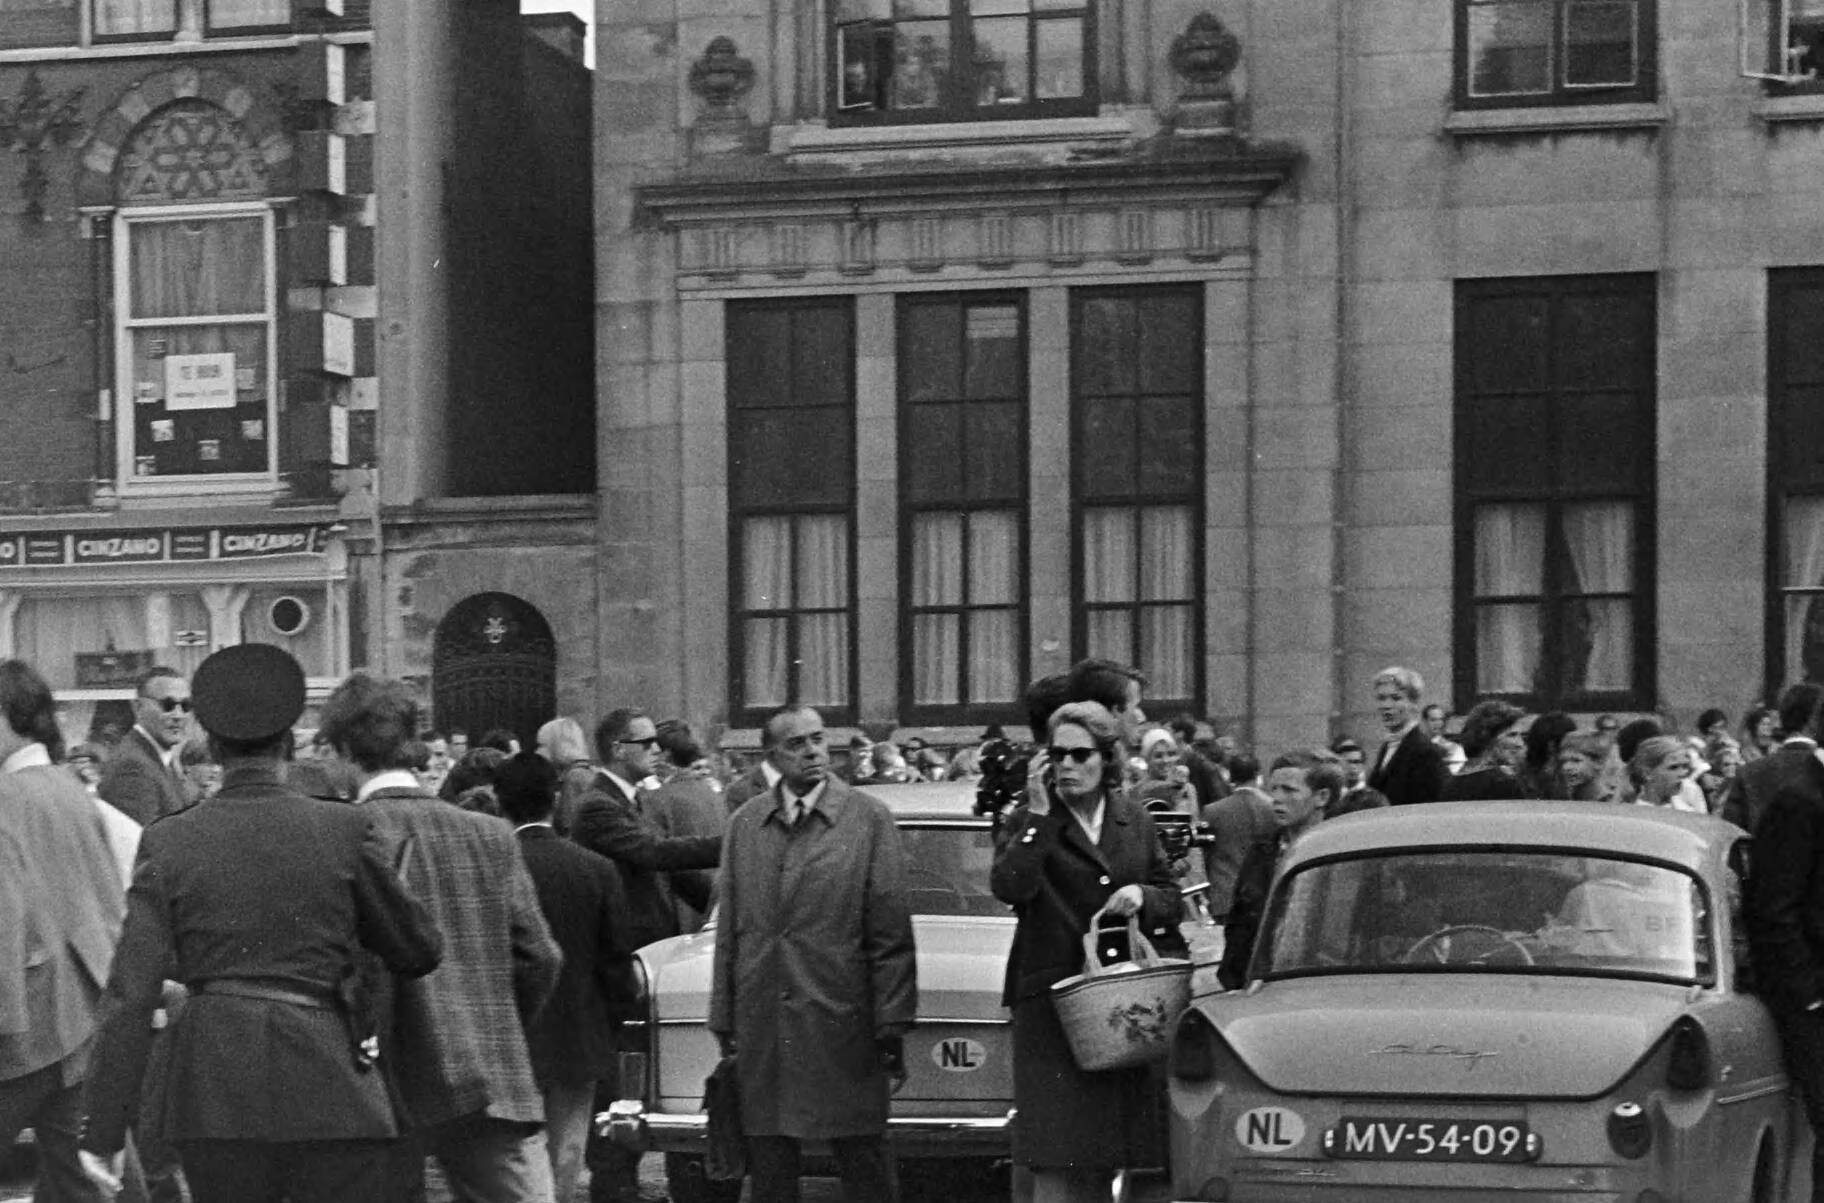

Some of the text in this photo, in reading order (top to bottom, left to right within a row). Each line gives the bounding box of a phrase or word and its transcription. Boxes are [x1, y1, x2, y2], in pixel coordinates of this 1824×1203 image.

[77, 537, 162, 556] CINZANO
[224, 533, 306, 551] CINZANO
[942, 1041, 976, 1067] NL
[1247, 1112, 1292, 1146] NL
[1345, 1122, 1521, 1155] MV-54-09
